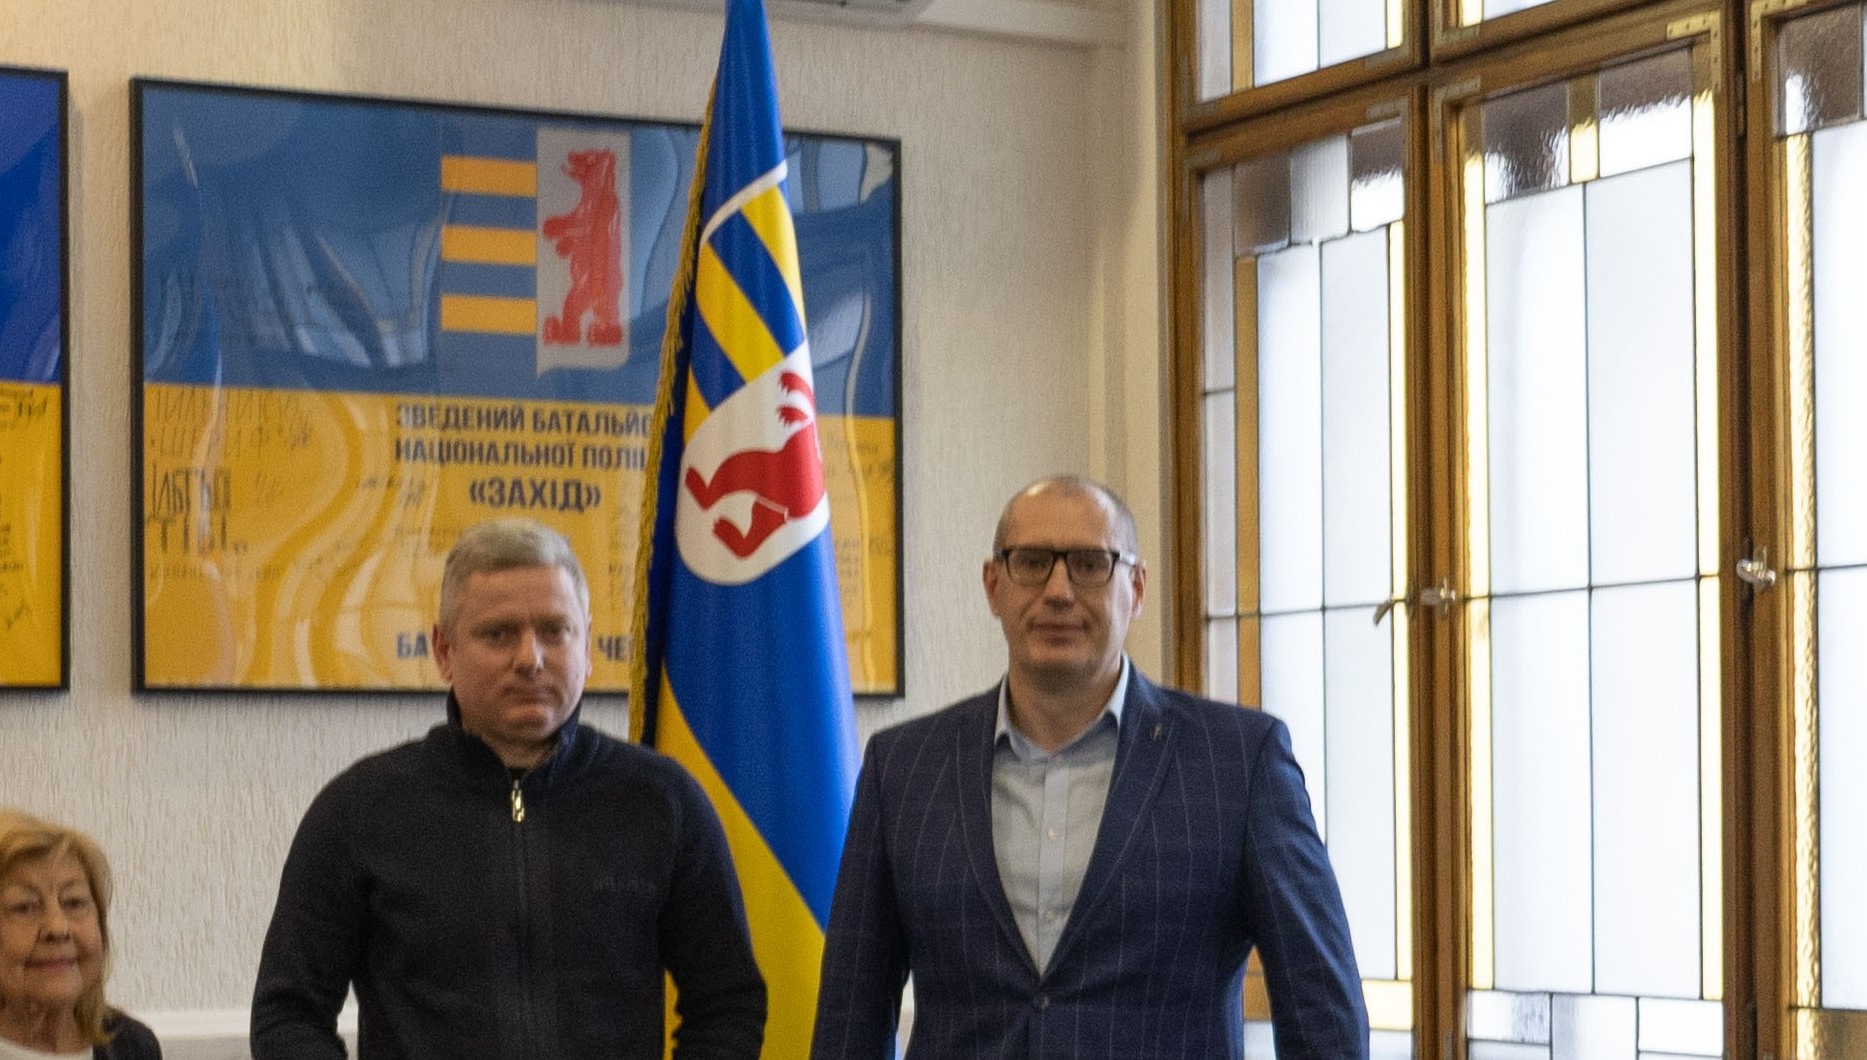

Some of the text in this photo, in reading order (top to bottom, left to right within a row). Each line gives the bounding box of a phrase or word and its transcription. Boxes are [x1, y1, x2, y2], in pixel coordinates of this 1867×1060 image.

[396, 403, 526, 432] ЗВЕДЕНИЙ
[395, 438, 575, 467] НАЦІОНАЛЬНОЇ
[469, 476, 601, 512] «ЗАХІД»
